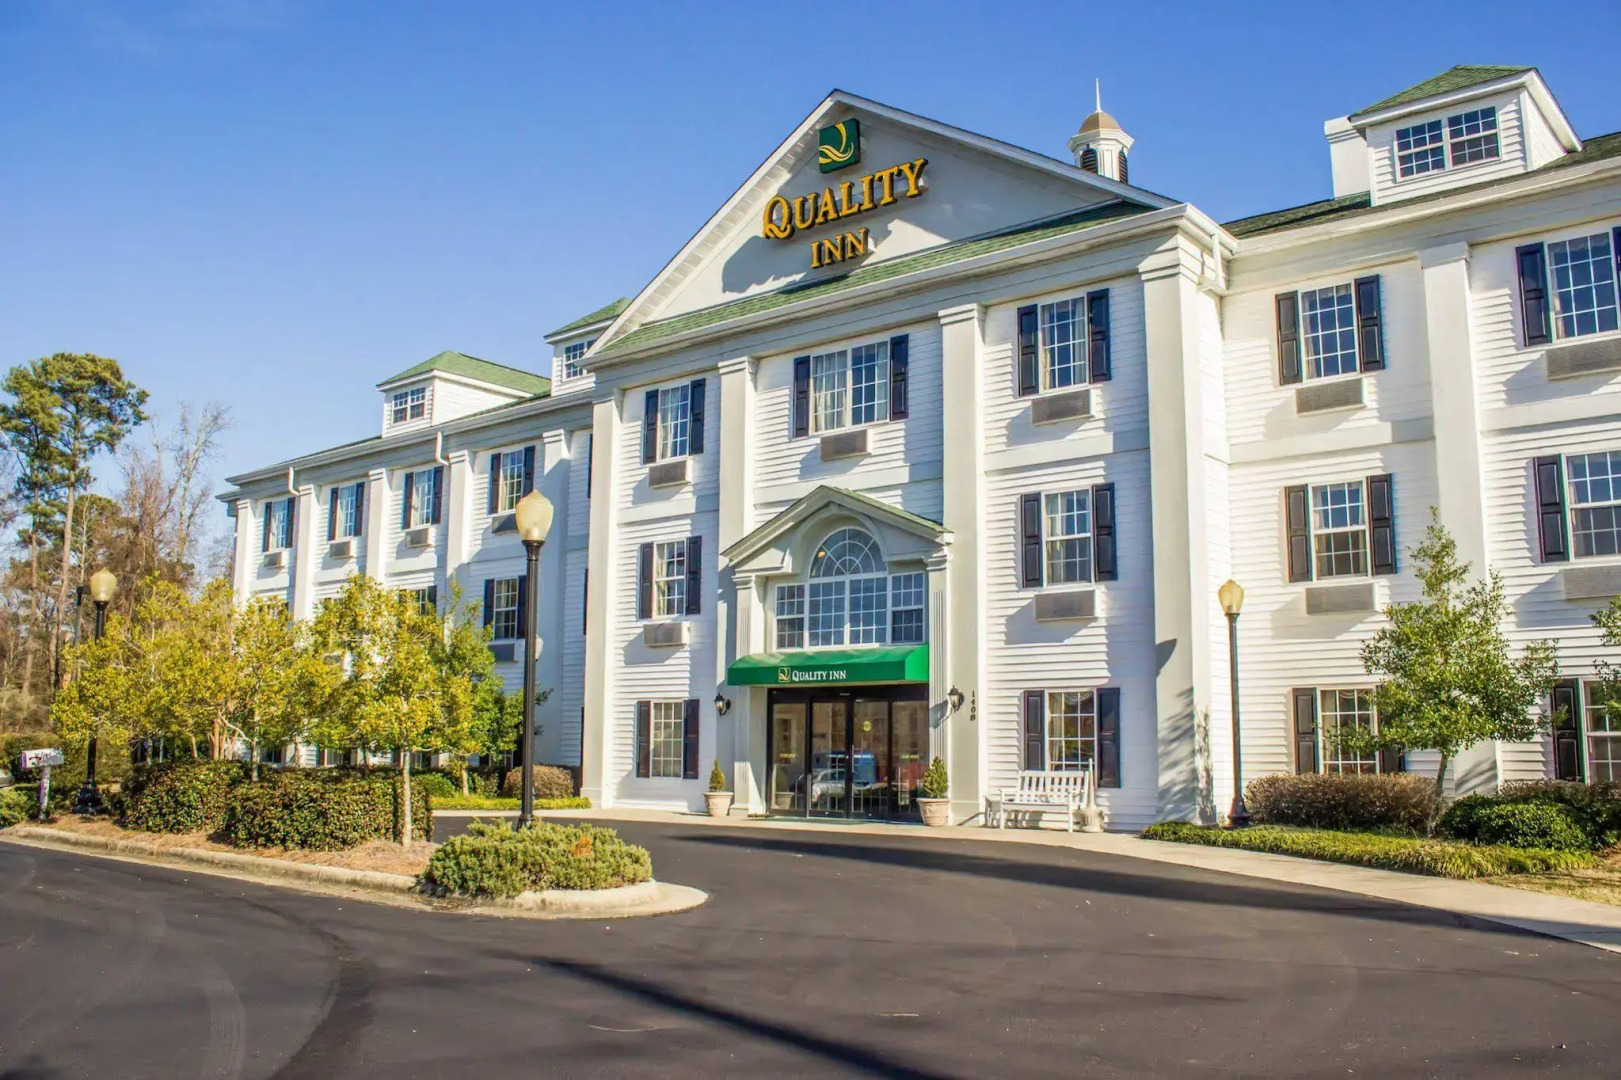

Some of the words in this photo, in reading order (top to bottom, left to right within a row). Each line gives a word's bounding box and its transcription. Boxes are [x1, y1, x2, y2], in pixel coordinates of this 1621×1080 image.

[762, 158, 929, 240] QUALITY
[810, 227, 870, 269] INN
[792, 670, 827, 681] QUALITY
[829, 670, 846, 680] INN
